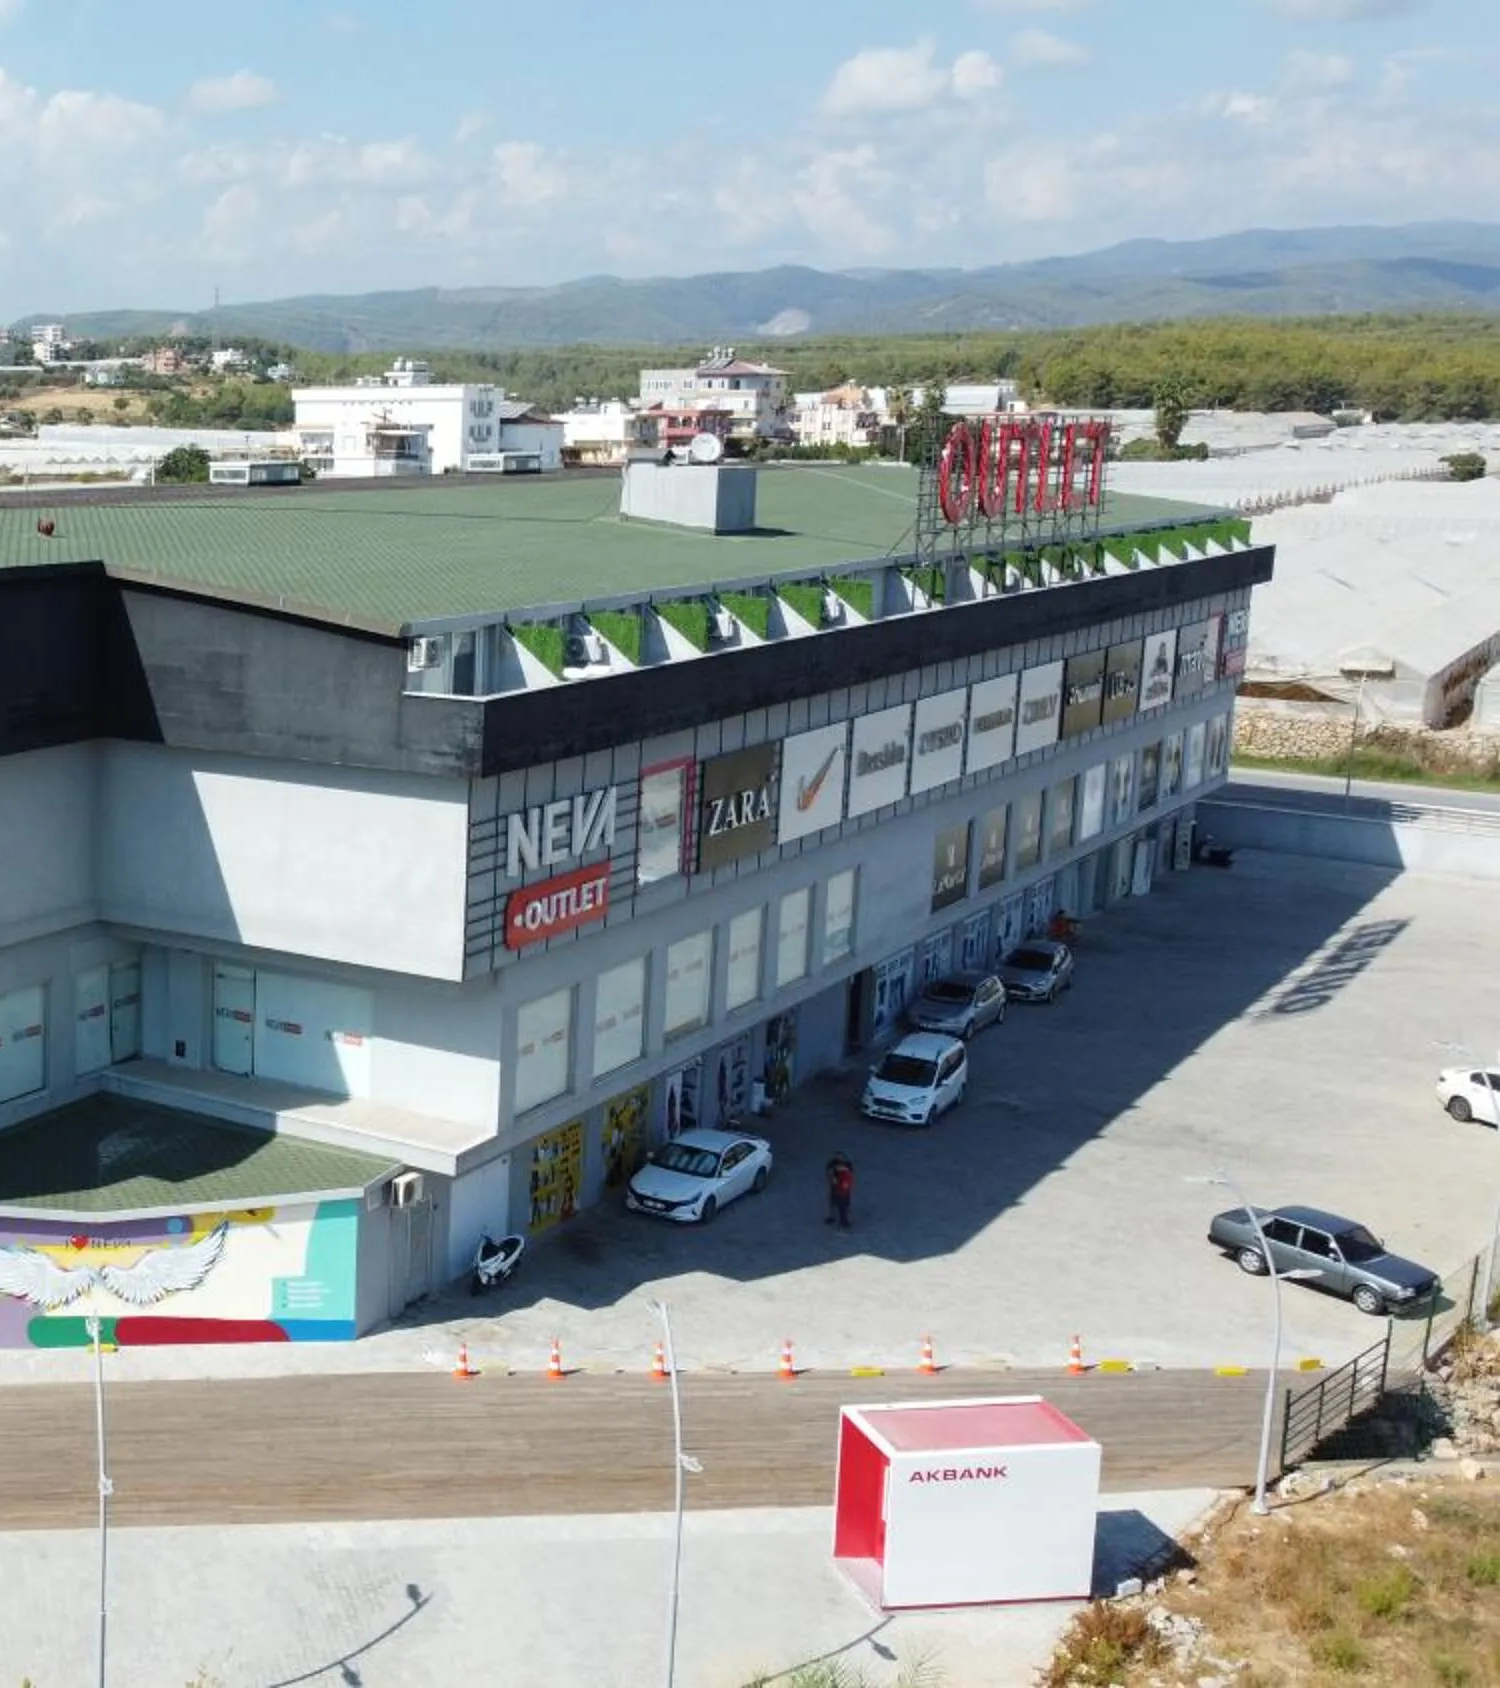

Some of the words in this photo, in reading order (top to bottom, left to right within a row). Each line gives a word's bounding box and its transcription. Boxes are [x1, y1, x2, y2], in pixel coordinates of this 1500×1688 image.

[505, 785, 618, 878] NEVA
[708, 787, 772, 837] ZARA
[524, 877, 607, 931] OUTLET
[908, 1465, 1008, 1483] AKBANK
